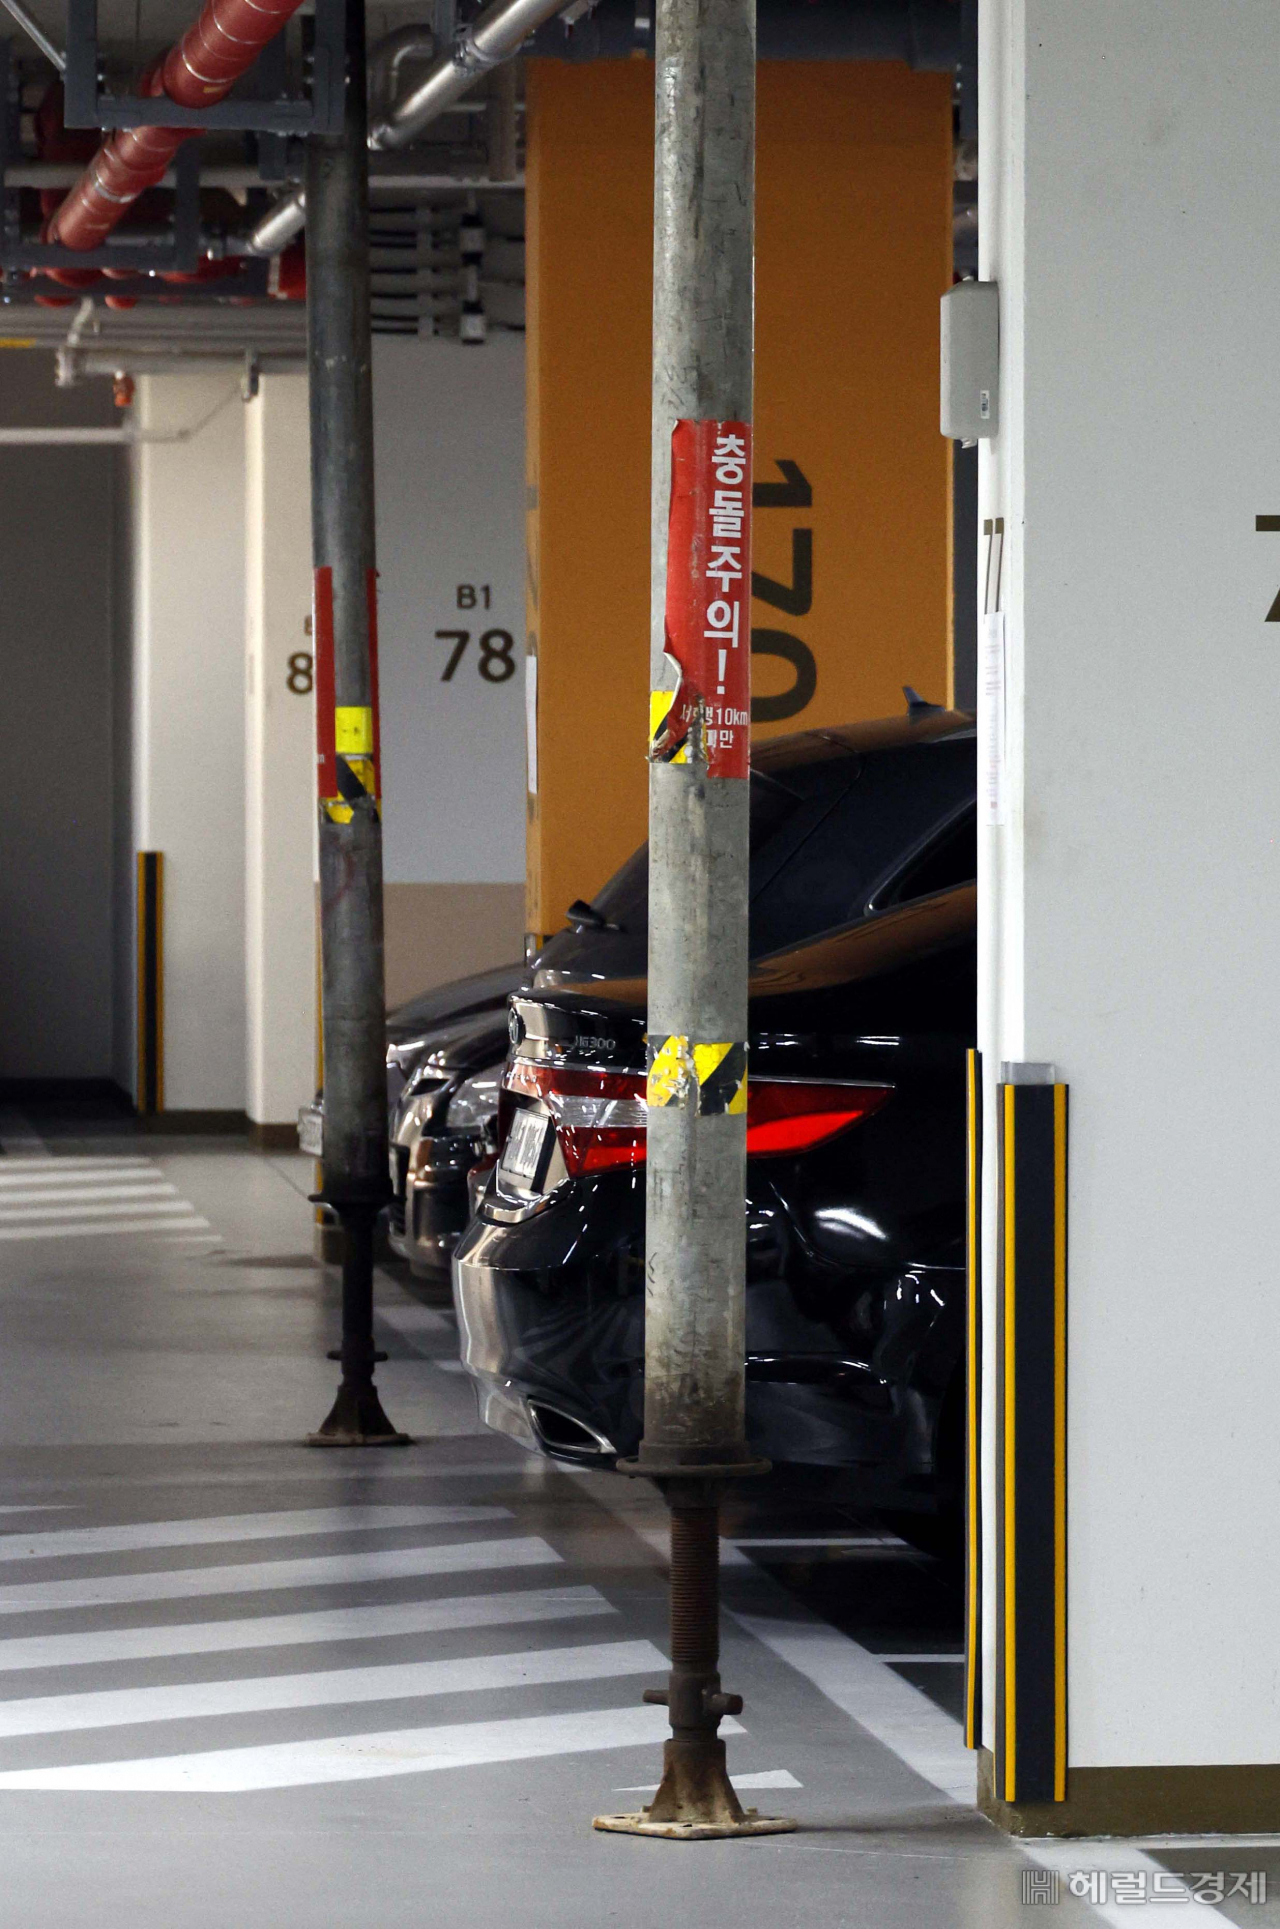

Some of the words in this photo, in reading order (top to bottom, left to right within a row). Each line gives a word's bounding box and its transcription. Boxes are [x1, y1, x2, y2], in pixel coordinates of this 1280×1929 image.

[703, 434, 746, 695] 충돌주의!
[456, 584, 491, 610] B1
[286, 652, 313, 695] 8
[434, 628, 516, 684] 78
